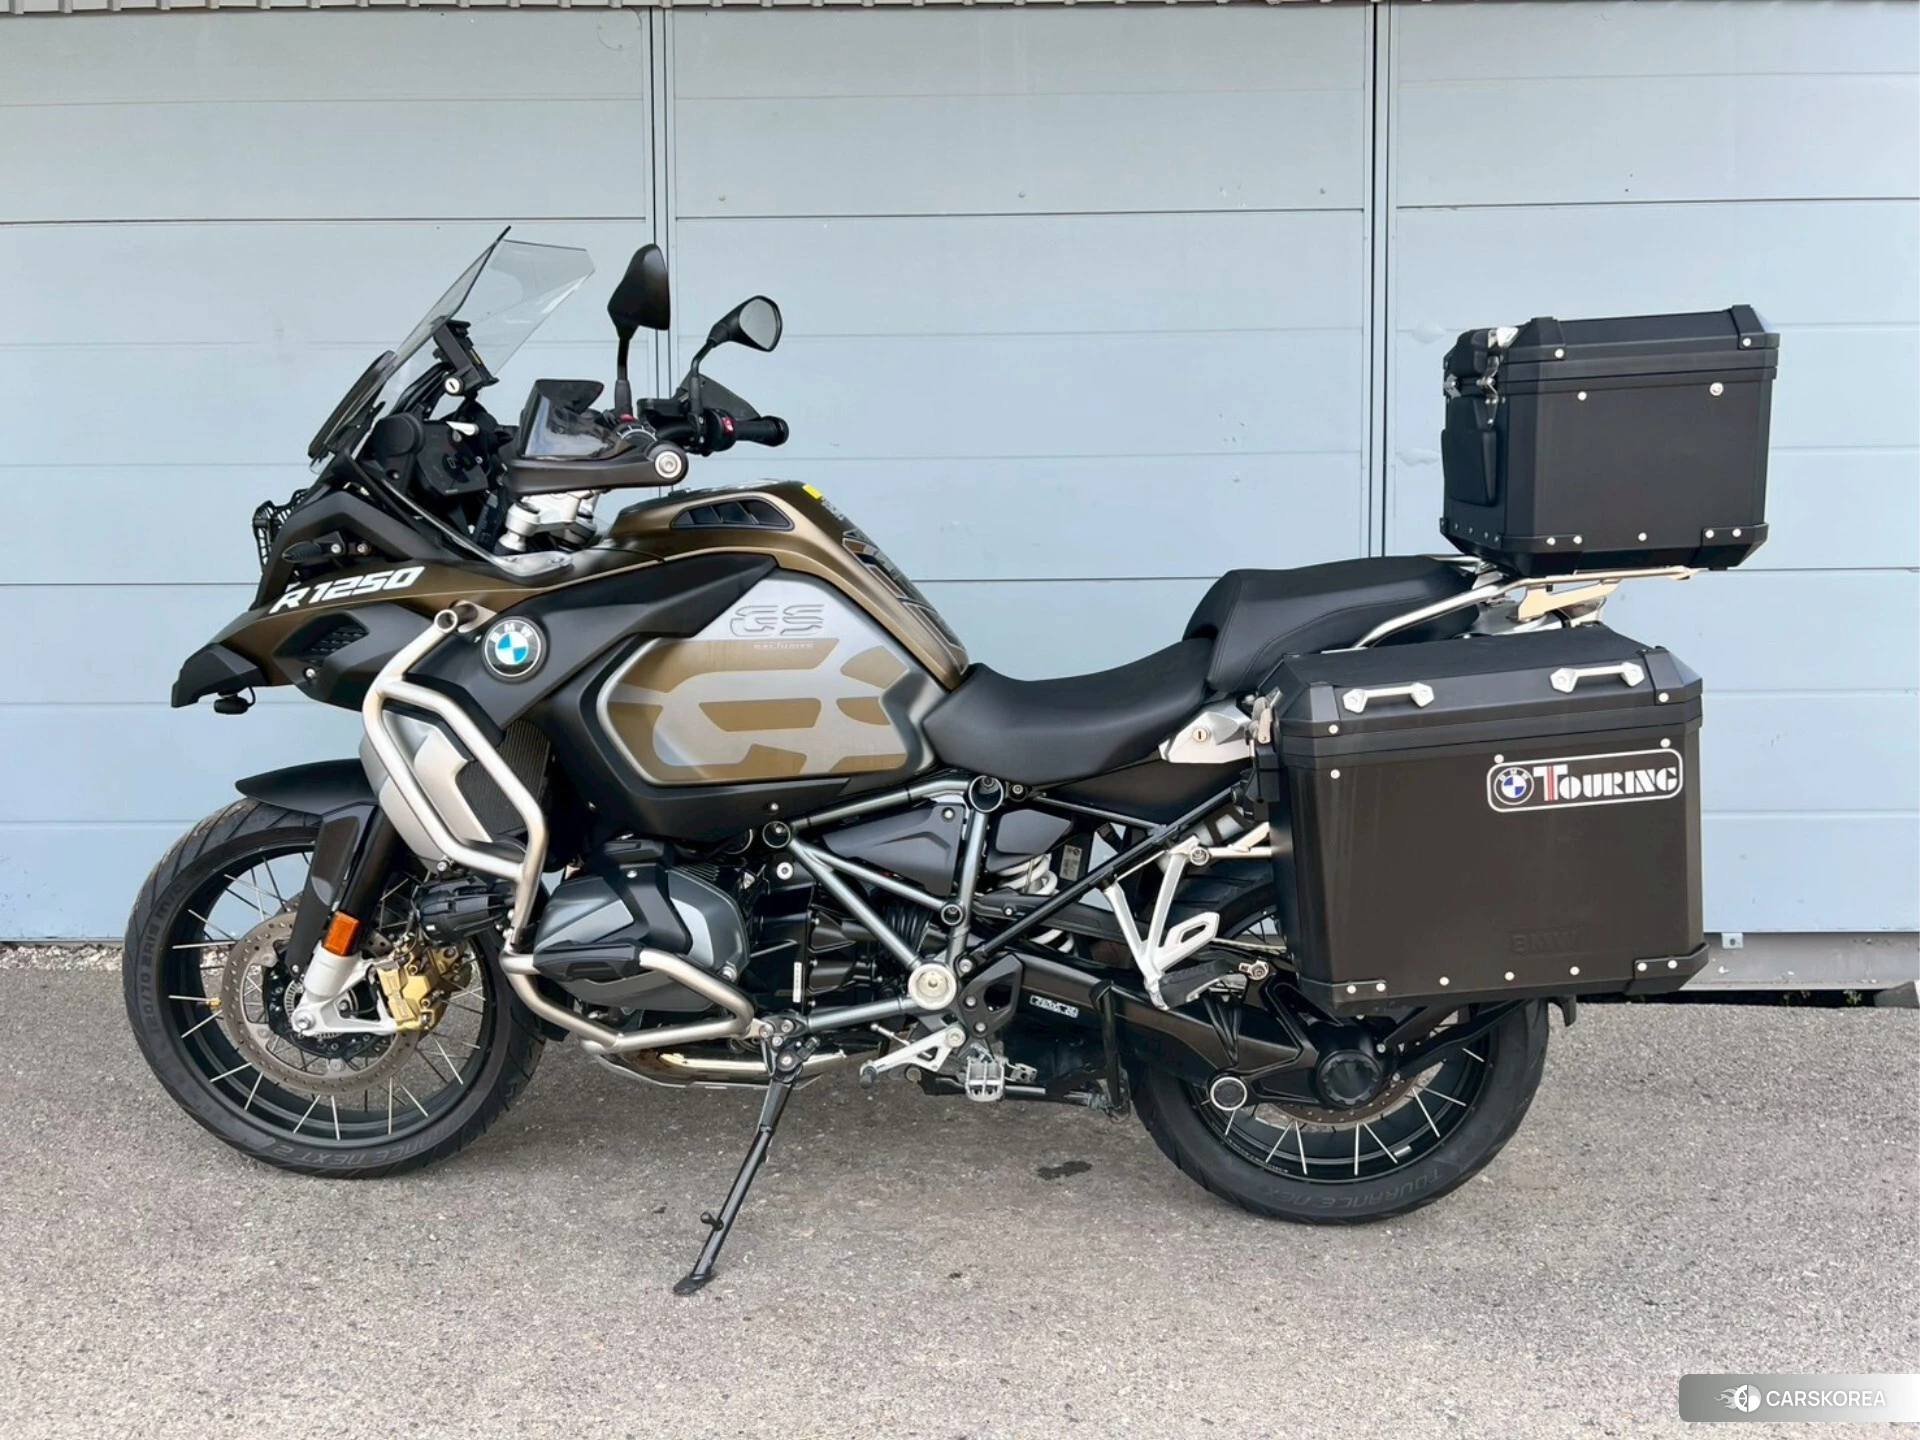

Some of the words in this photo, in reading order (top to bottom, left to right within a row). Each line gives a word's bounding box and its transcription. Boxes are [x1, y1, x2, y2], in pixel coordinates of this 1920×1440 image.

[268, 586, 311, 615] R
[308, 566, 426, 604] 1250
[729, 604, 825, 637] GS
[1509, 930, 1580, 954] BMW
[1315, 1167, 1442, 1210] TOURANCE
